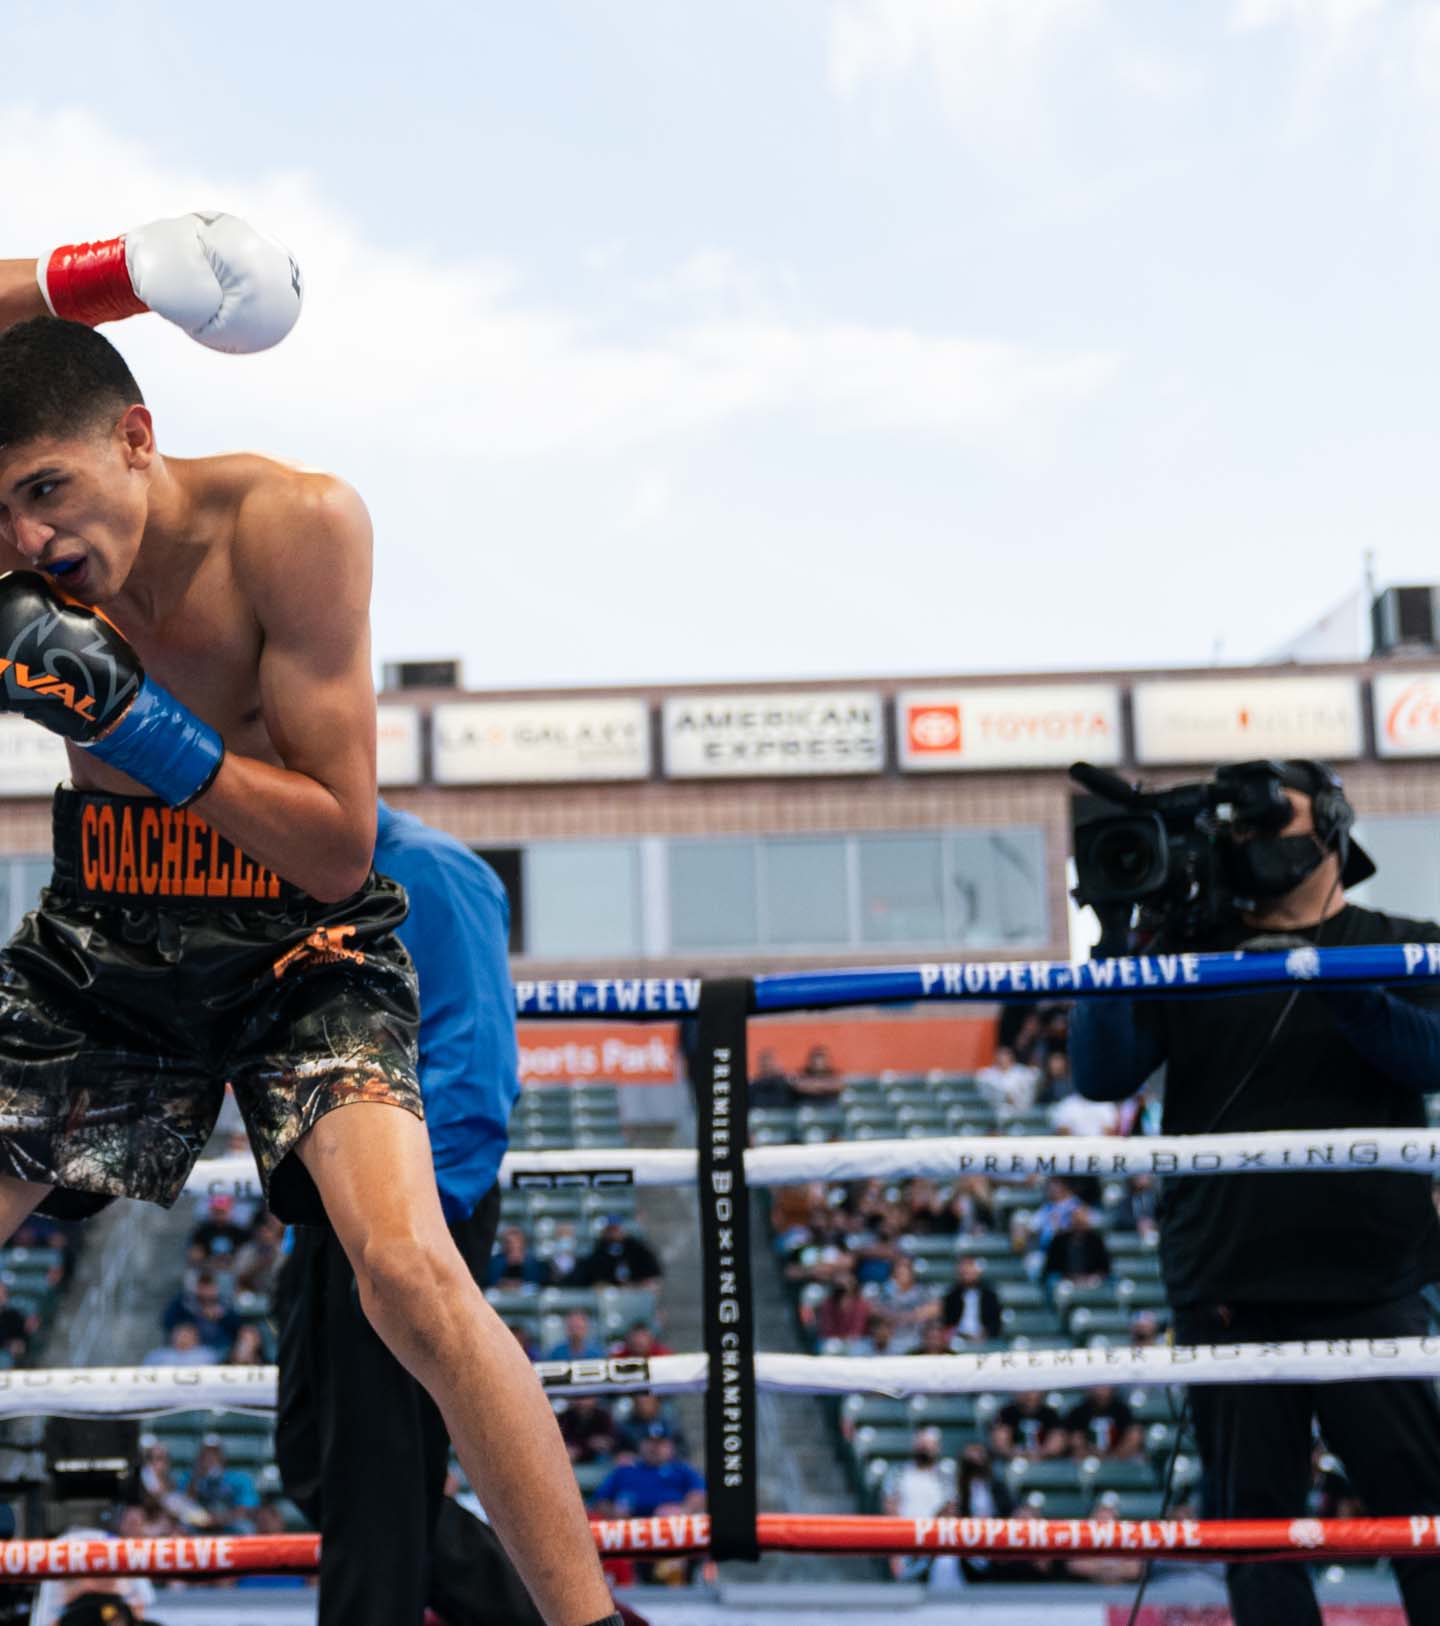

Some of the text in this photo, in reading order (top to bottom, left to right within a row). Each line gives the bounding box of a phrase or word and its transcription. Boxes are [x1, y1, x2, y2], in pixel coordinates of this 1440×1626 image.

[675, 701, 873, 733] AMERICAN
[976, 711, 1111, 740] TOYOTA
[703, 736, 879, 761] EXPRESS
[919, 953, 1201, 995] PROPER TWELVE
[515, 979, 578, 1012] PER
[596, 978, 702, 1012] TWELV
[518, 1036, 671, 1078] ports Park
[959, 1153, 1128, 1174] PREMIER
[1151, 1140, 1380, 1174] BOXING
[712, 1047, 744, 1488] PREMIER BOXING CHAMPIONS
[594, 1513, 711, 1550] WELVE
[914, 1517, 1049, 1548] PROPER
[1068, 1518, 1203, 1549] TWELVE
[106, 1537, 235, 1571] TWELVE
